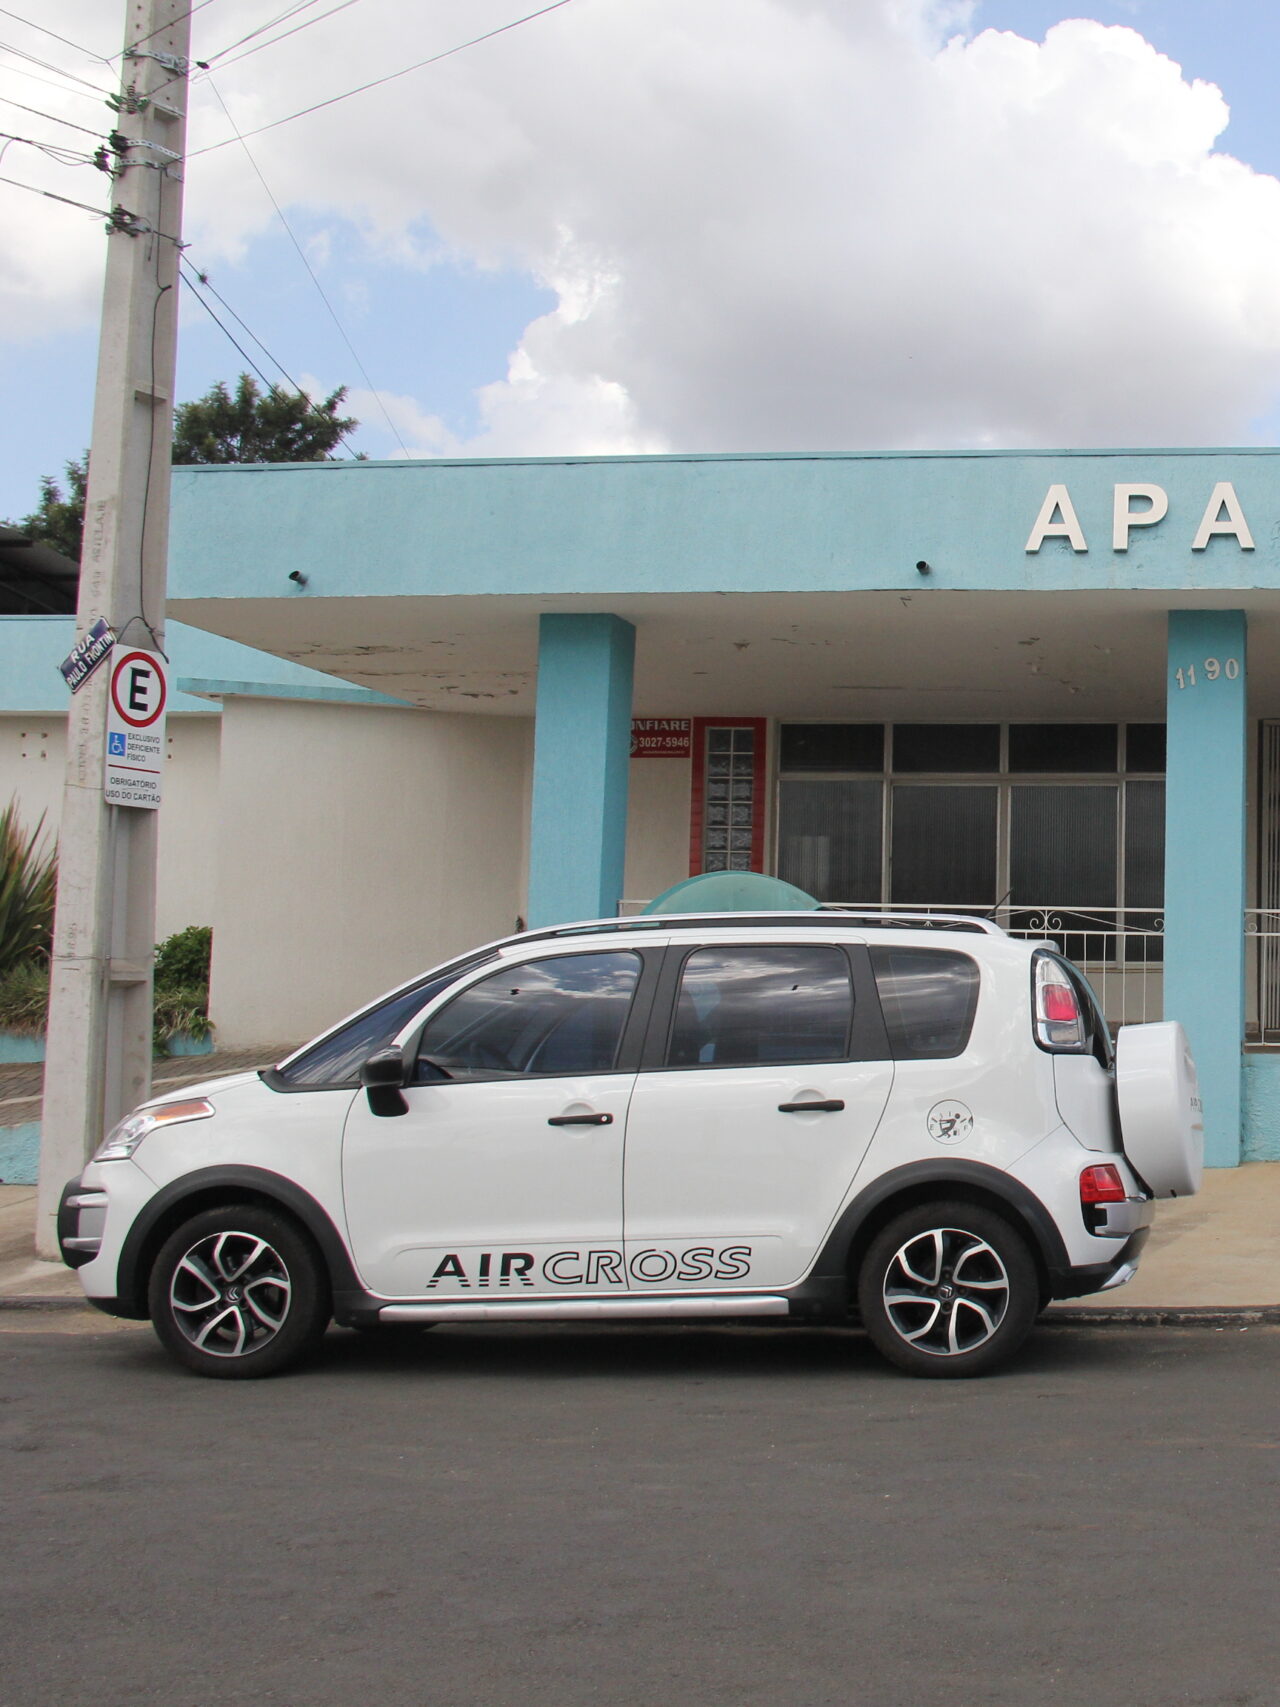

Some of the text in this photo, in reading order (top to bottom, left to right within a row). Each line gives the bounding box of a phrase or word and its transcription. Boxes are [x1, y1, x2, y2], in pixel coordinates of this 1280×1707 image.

[71, 634, 95, 664] RUA
[66, 661, 88, 689] PAULO
[1175, 657, 1240, 689] 1190
[129, 666, 152, 712] E
[127, 733, 160, 744] EXCLUSIVO
[127, 743, 160, 754] DEFICIENTE
[639, 737, 690, 748] 3027-5946
[110, 776, 157, 790] OBRIGATÓRIO
[105, 790, 120, 798] USO
[122, 791, 132, 800] DO
[426, 1246, 752, 1288] AIRCROSS
